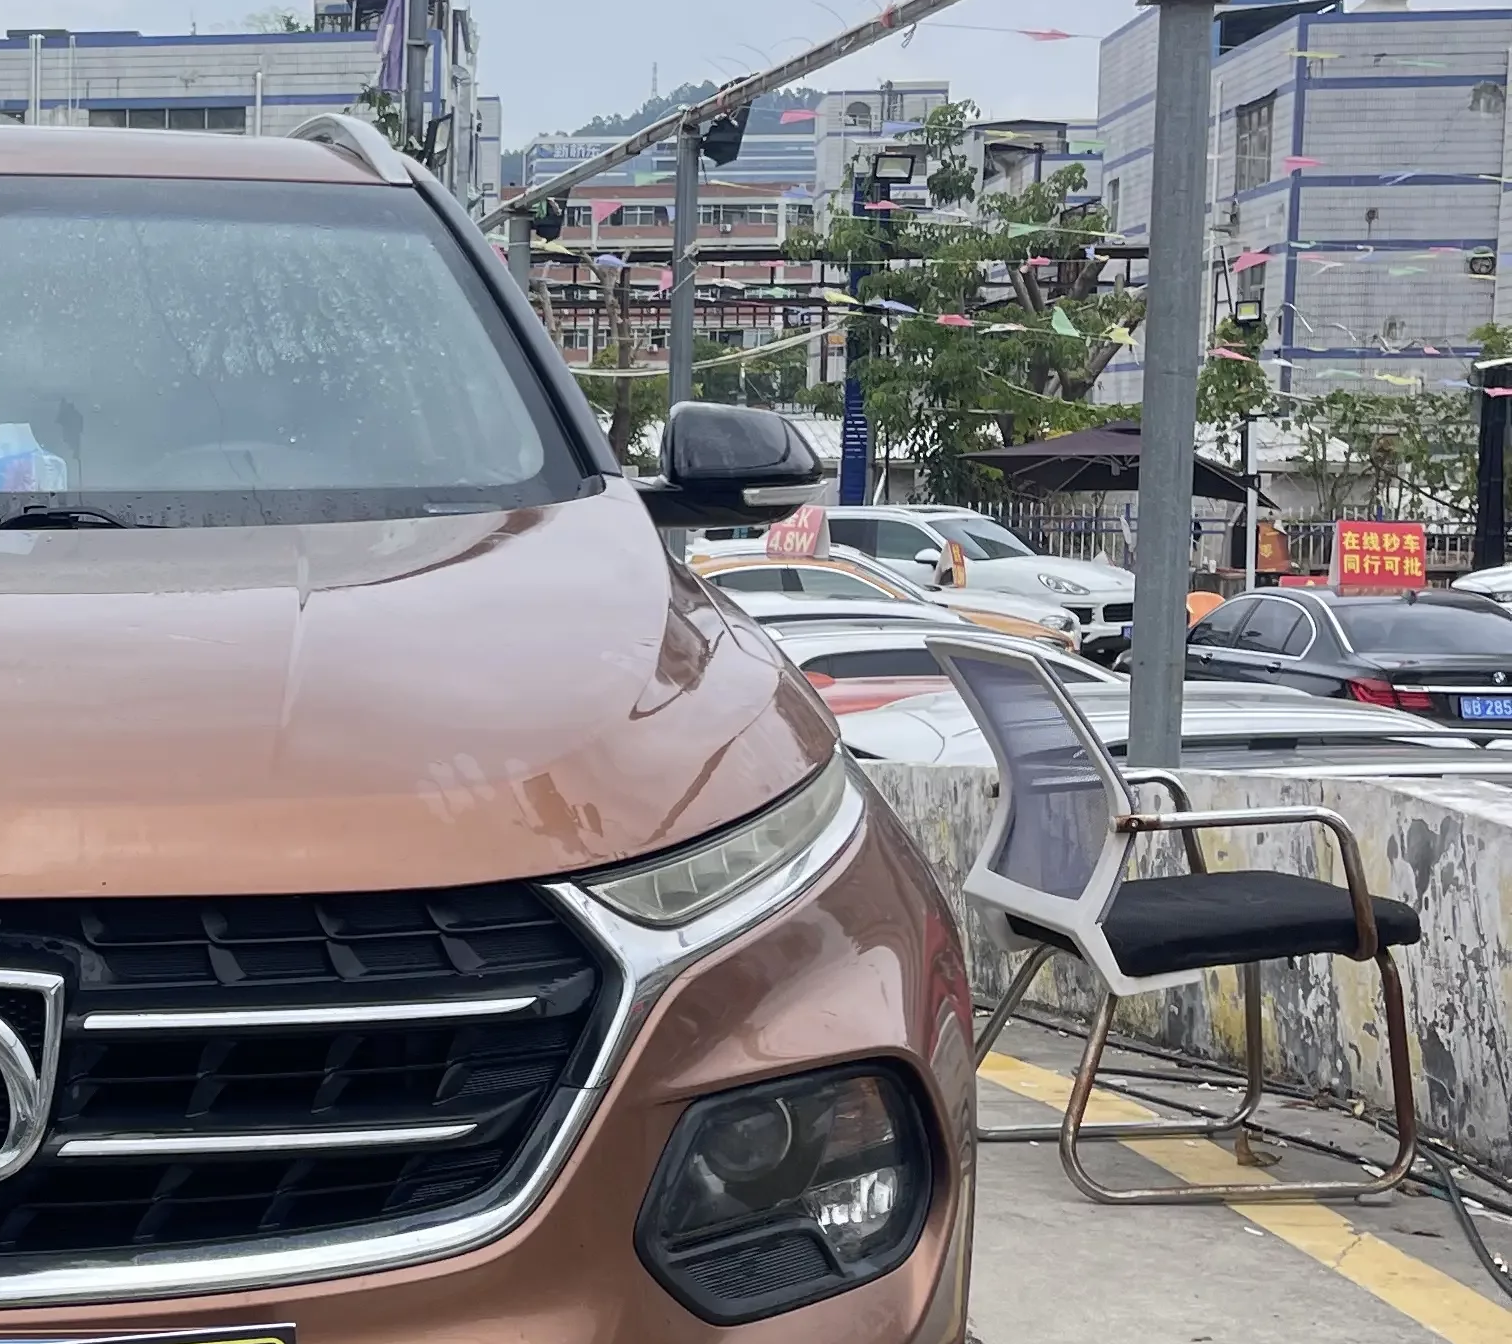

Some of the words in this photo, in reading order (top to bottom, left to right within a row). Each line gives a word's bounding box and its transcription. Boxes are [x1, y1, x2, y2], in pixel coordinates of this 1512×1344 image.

[769, 530, 815, 553] 4.8W
[1342, 531, 1421, 553] 在线秒车
[1343, 554, 1422, 577] 同行可批
